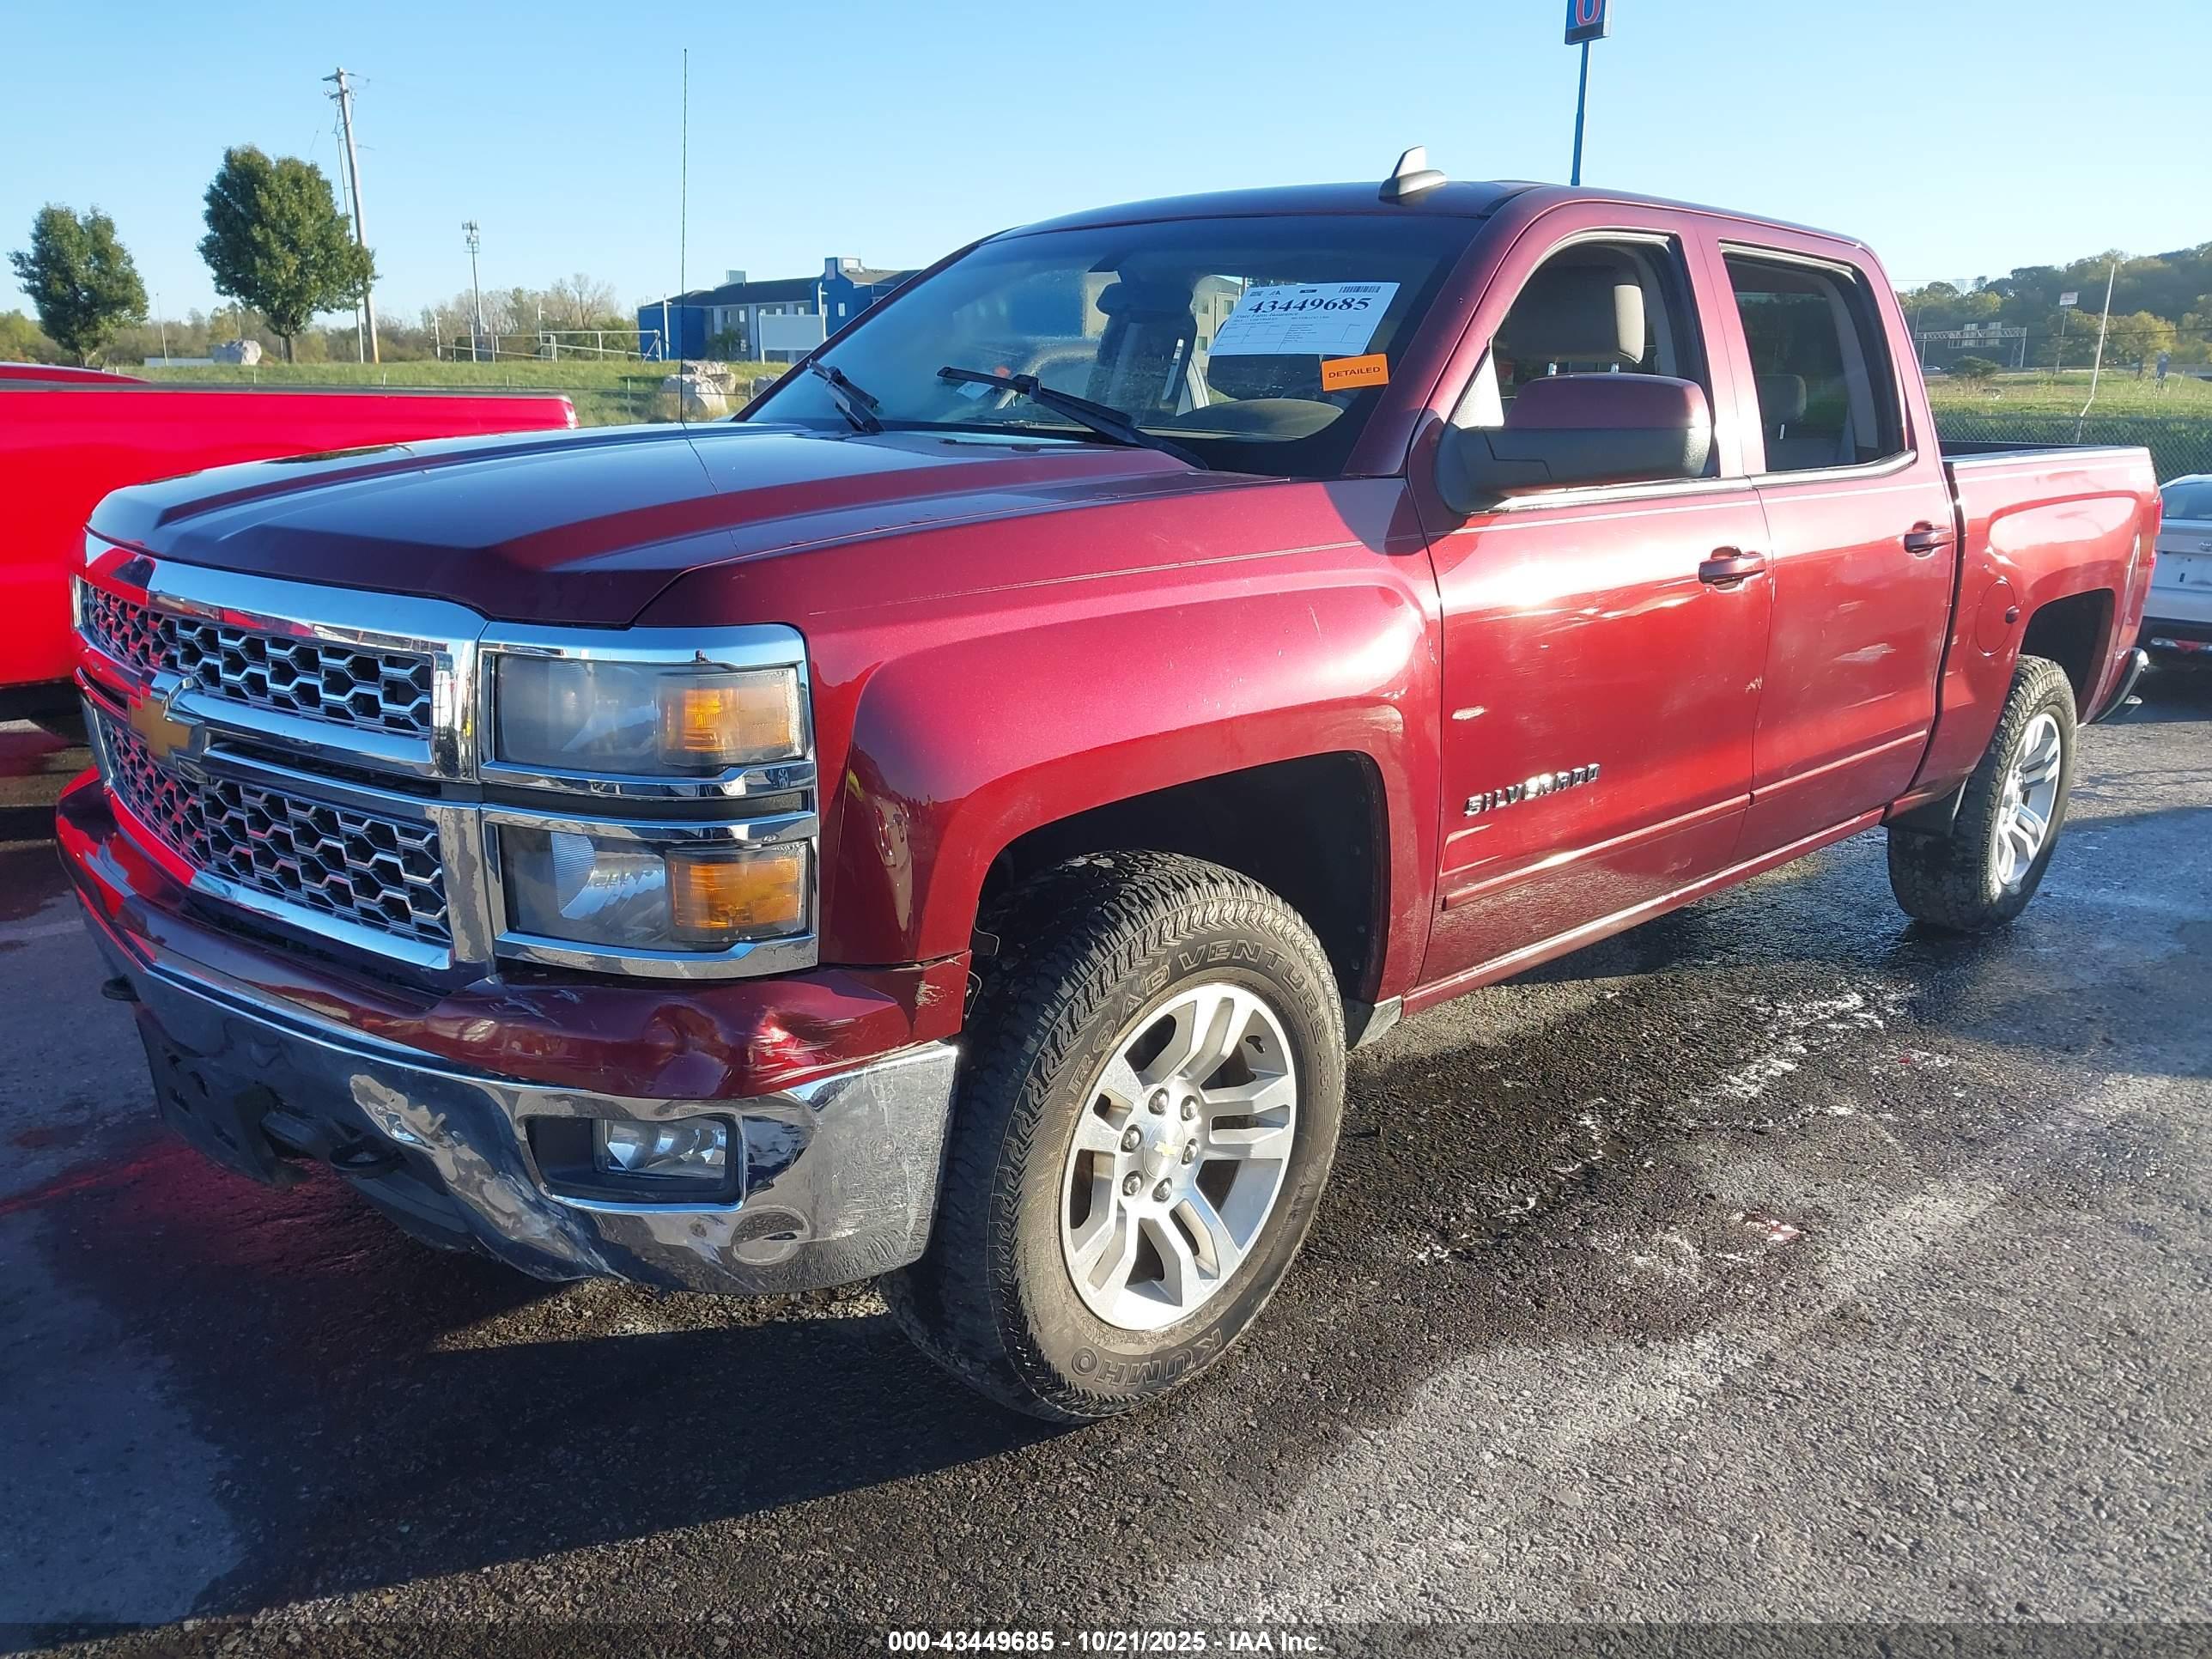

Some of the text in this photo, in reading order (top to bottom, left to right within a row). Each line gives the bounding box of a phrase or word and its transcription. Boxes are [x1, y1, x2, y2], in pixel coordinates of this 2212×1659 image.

[1248, 297, 1374, 313] 43449685
[1328, 366, 1381, 379] DETAILED
[1066, 939, 1328, 1096] ROAD VENTURE
[1071, 1328, 1223, 1386] KUMHO
